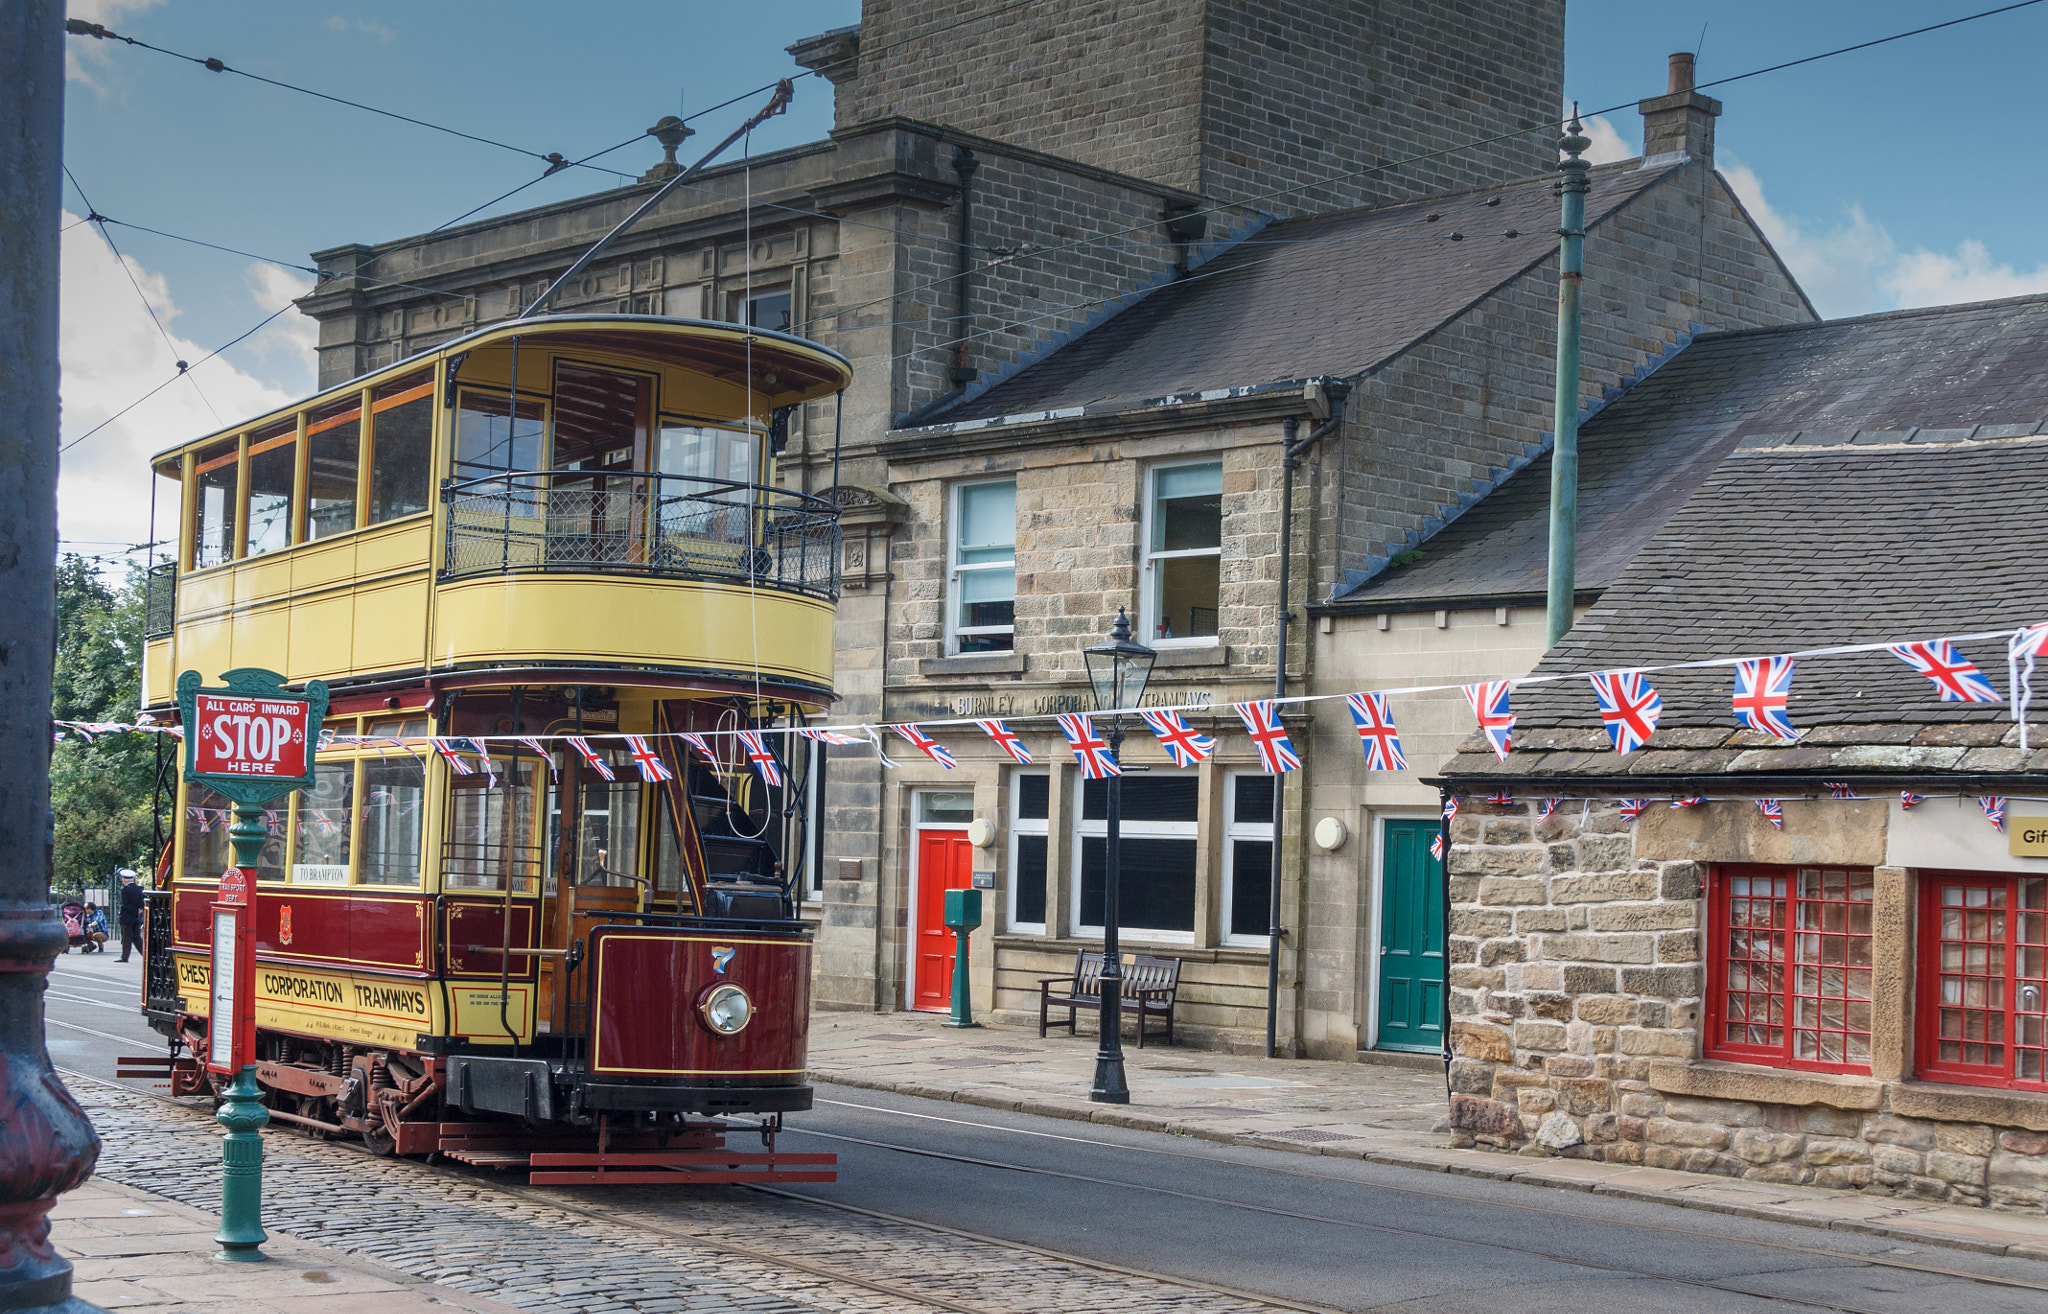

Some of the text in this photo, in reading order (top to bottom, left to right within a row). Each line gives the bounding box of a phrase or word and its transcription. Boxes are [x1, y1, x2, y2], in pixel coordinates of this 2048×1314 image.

[205, 700, 300, 716] ALL CARS INWARD
[957, 696, 1015, 716] BURNLEY
[1142, 691, 1211, 713] TRAMWAYS
[213, 714, 292, 762] STOP
[460, 739, 467, 747] 7
[227, 761, 275, 774] HERE
[2023, 829, 2048, 844] Gif
[300, 868, 343, 880] TO BRAMPTON
[219, 883, 246, 892] TRANSPORT
[711, 945, 736, 975] 7
[180, 962, 210, 986] CHEST
[264, 973, 343, 1004] CORPORATION
[354, 985, 425, 1015] TRAMWAYS
